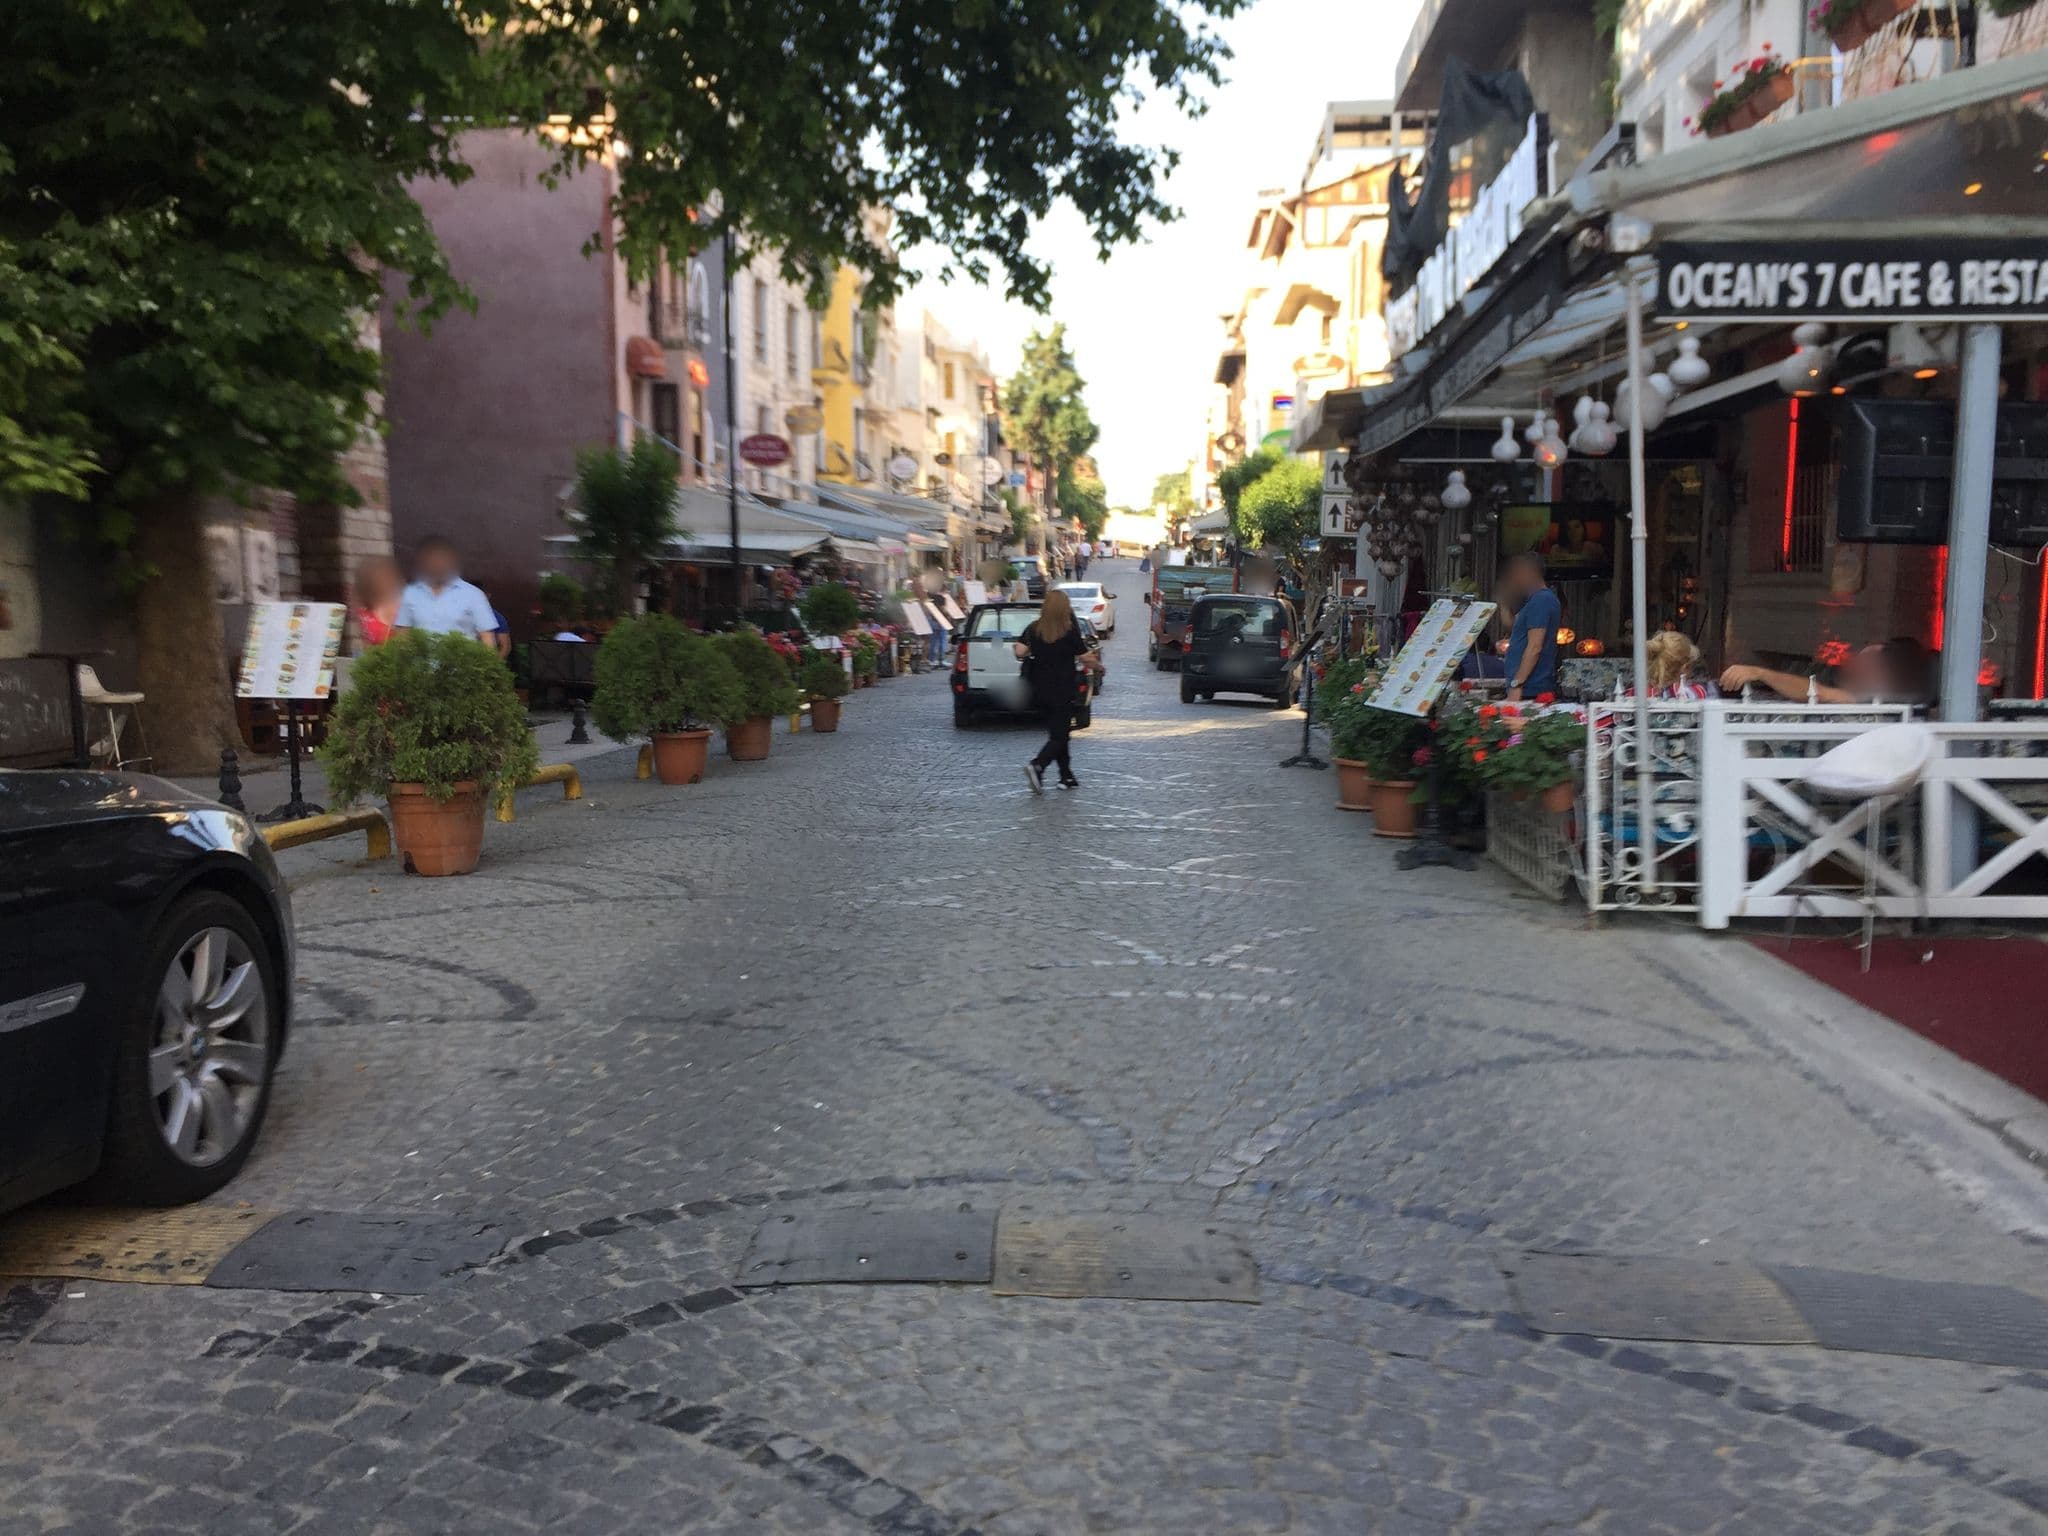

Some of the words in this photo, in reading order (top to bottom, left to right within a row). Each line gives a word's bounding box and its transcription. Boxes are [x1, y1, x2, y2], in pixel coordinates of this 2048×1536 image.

[1668, 262, 1809, 308] OCEAN'S
[1815, 262, 1837, 308] 7
[1839, 261, 1922, 308] CAFE
[1927, 260, 1955, 306] &
